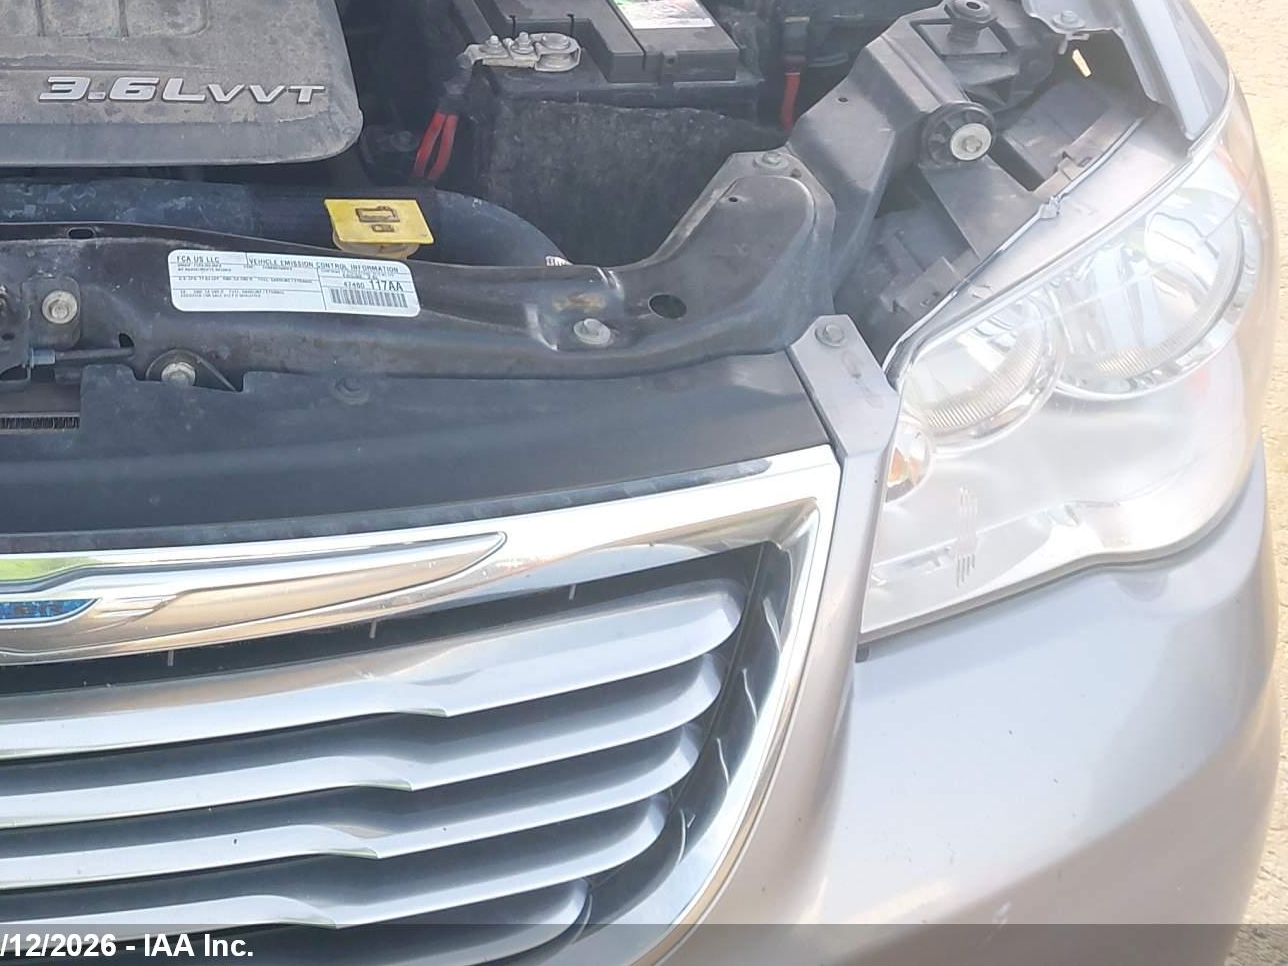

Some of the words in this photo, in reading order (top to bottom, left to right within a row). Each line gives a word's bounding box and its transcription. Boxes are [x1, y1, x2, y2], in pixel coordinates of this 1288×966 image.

[176, 255, 191, 264] FCA
[193, 255, 204, 264] US
[206, 255, 220, 264] LLC
[249, 257, 277, 266] VEHICLE
[280, 258, 314, 267] EMISSION
[316, 261, 346, 270] CONTROL
[350, 264, 399, 273] INFORMATION
[370, 280, 404, 292] 117AA
